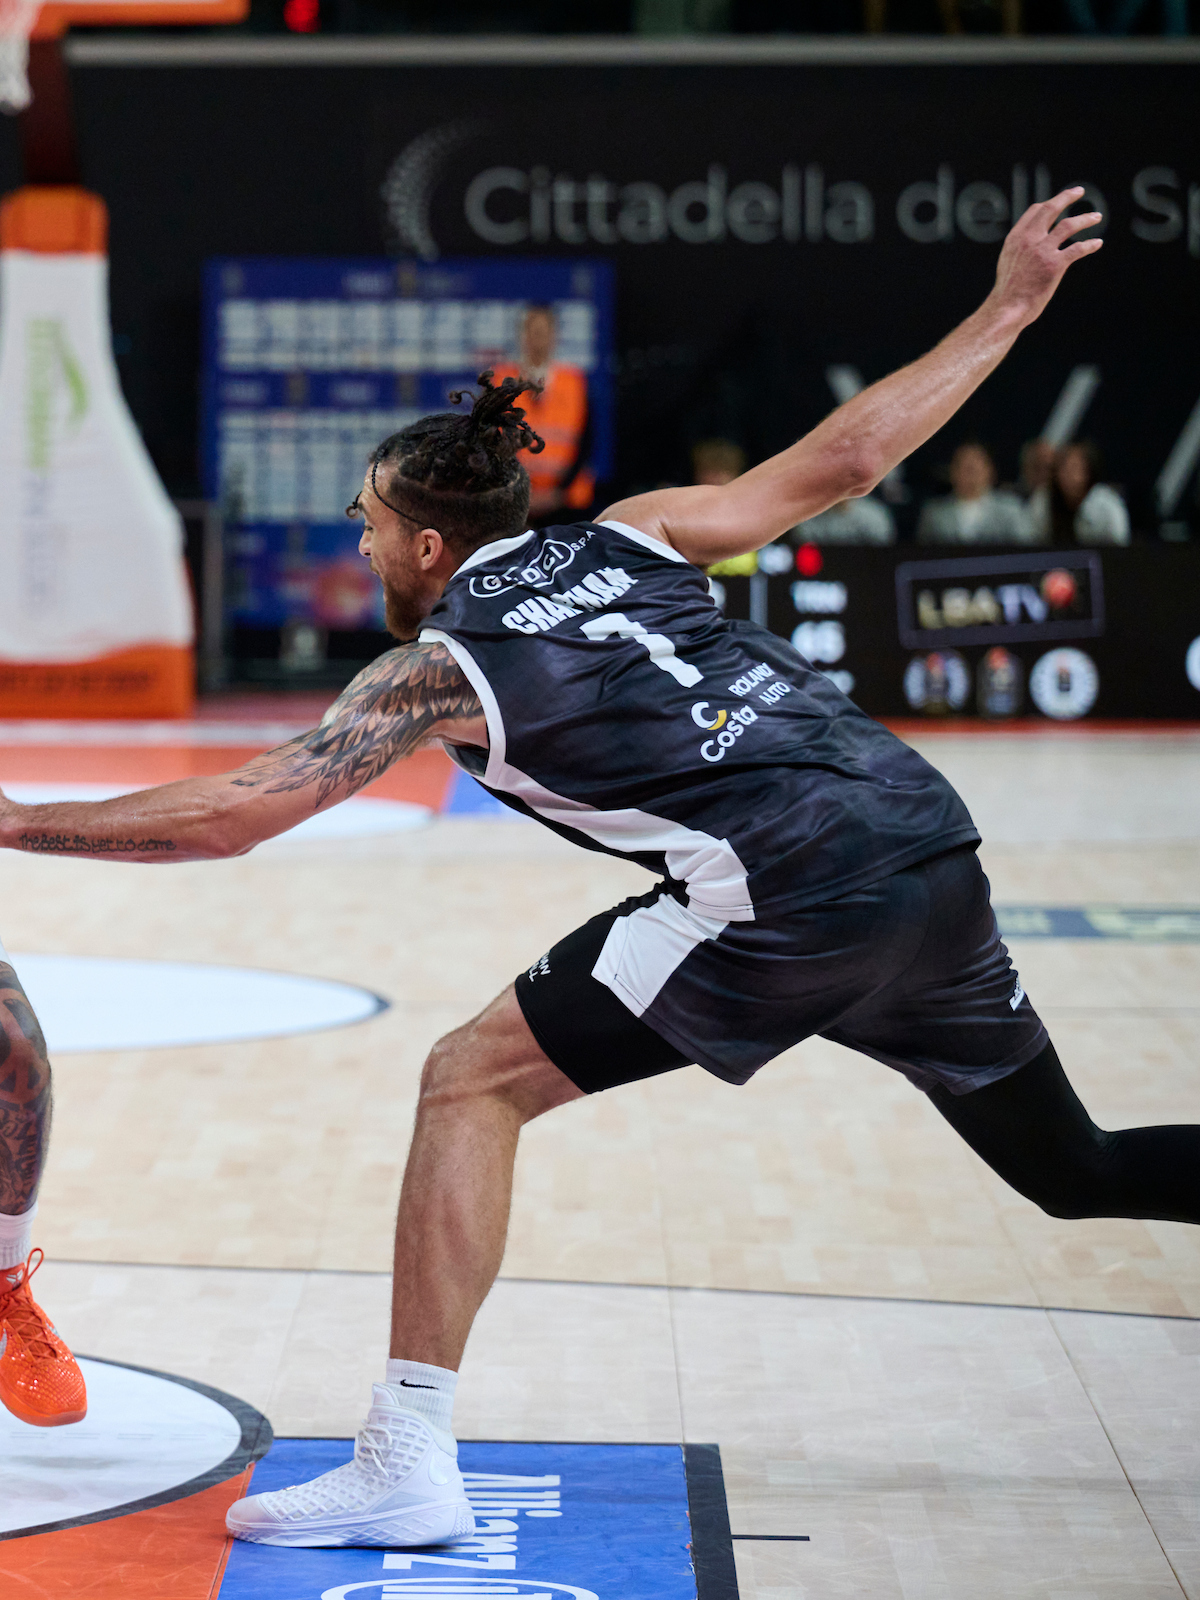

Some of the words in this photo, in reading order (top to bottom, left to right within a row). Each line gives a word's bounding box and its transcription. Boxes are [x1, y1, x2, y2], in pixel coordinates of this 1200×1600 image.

[463, 163, 877, 246] Cittadella
[502, 566, 639, 635] CHAPMAN
[727, 662, 776, 697] ROLANDI
[758, 681, 791, 706] AUTO
[700, 704, 759, 763] Costa
